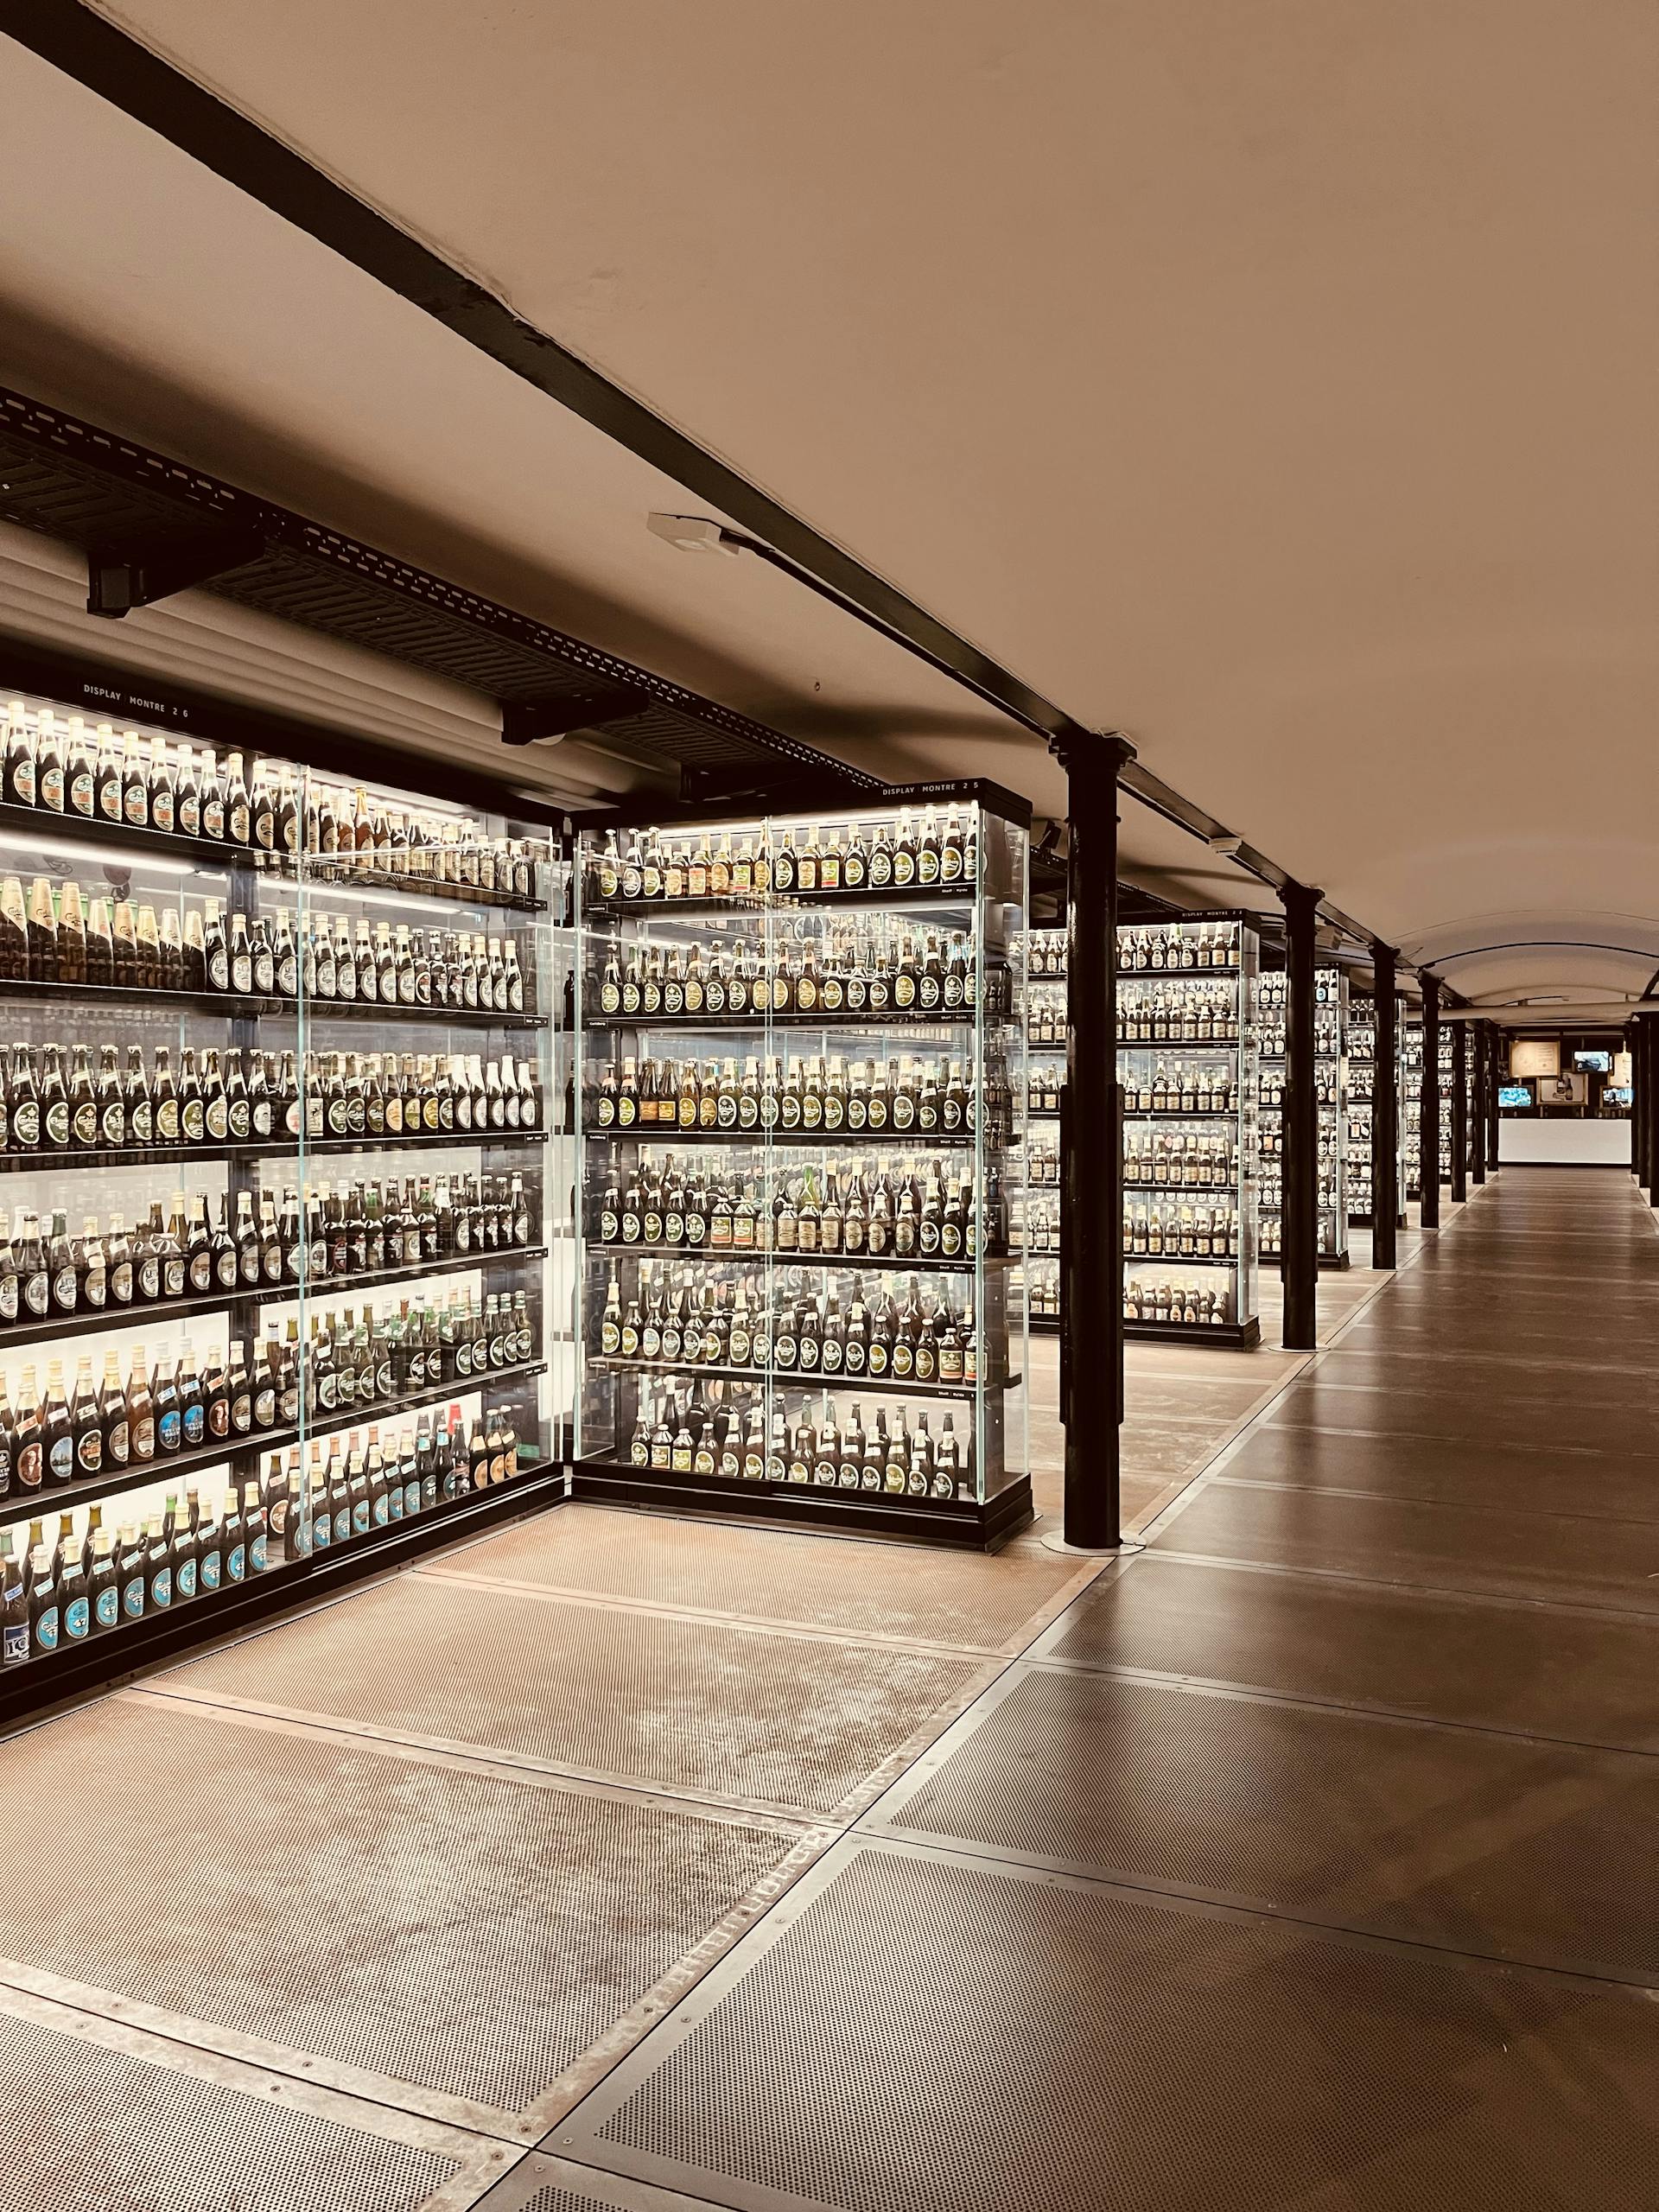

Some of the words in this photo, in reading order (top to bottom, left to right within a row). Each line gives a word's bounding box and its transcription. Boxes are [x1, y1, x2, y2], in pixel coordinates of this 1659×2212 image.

[83, 683, 121, 701] DISPLAY
[130, 696, 165, 713] MONTRE
[882, 786, 915, 796] DISPLAY
[922, 783, 956, 792] MONTRE
